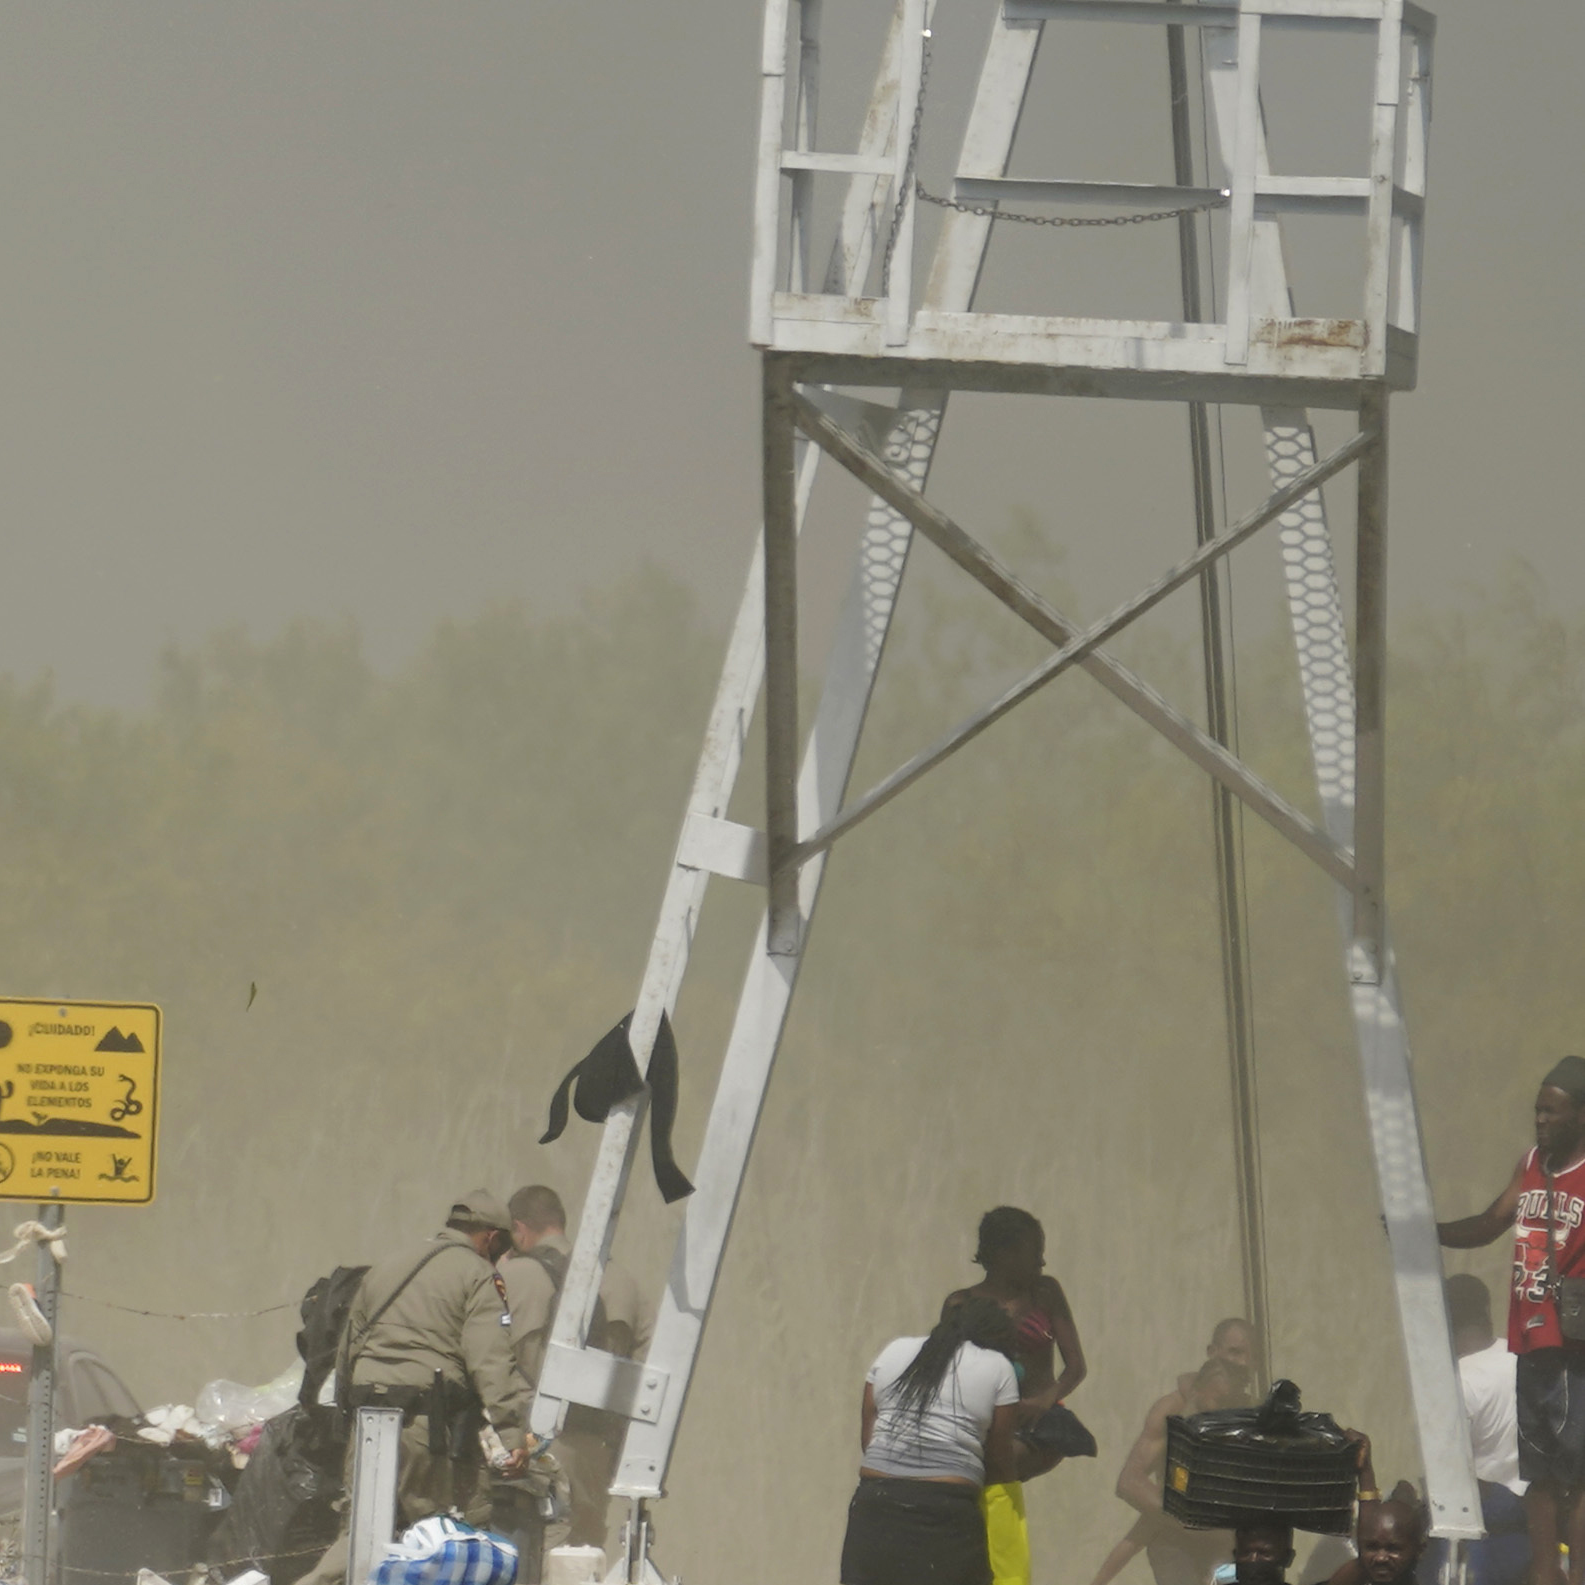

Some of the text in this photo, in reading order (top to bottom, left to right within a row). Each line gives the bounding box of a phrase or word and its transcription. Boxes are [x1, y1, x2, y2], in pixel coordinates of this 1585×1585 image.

[17, 1063, 105, 1077] NO EXPONGA SU
[30, 1081, 89, 1092] VIDA A LOS
[26, 1096, 92, 1108] ELEMENTOS
[55, 1152, 82, 1163] VALE
[31, 1168, 81, 1179] LA PENA!
